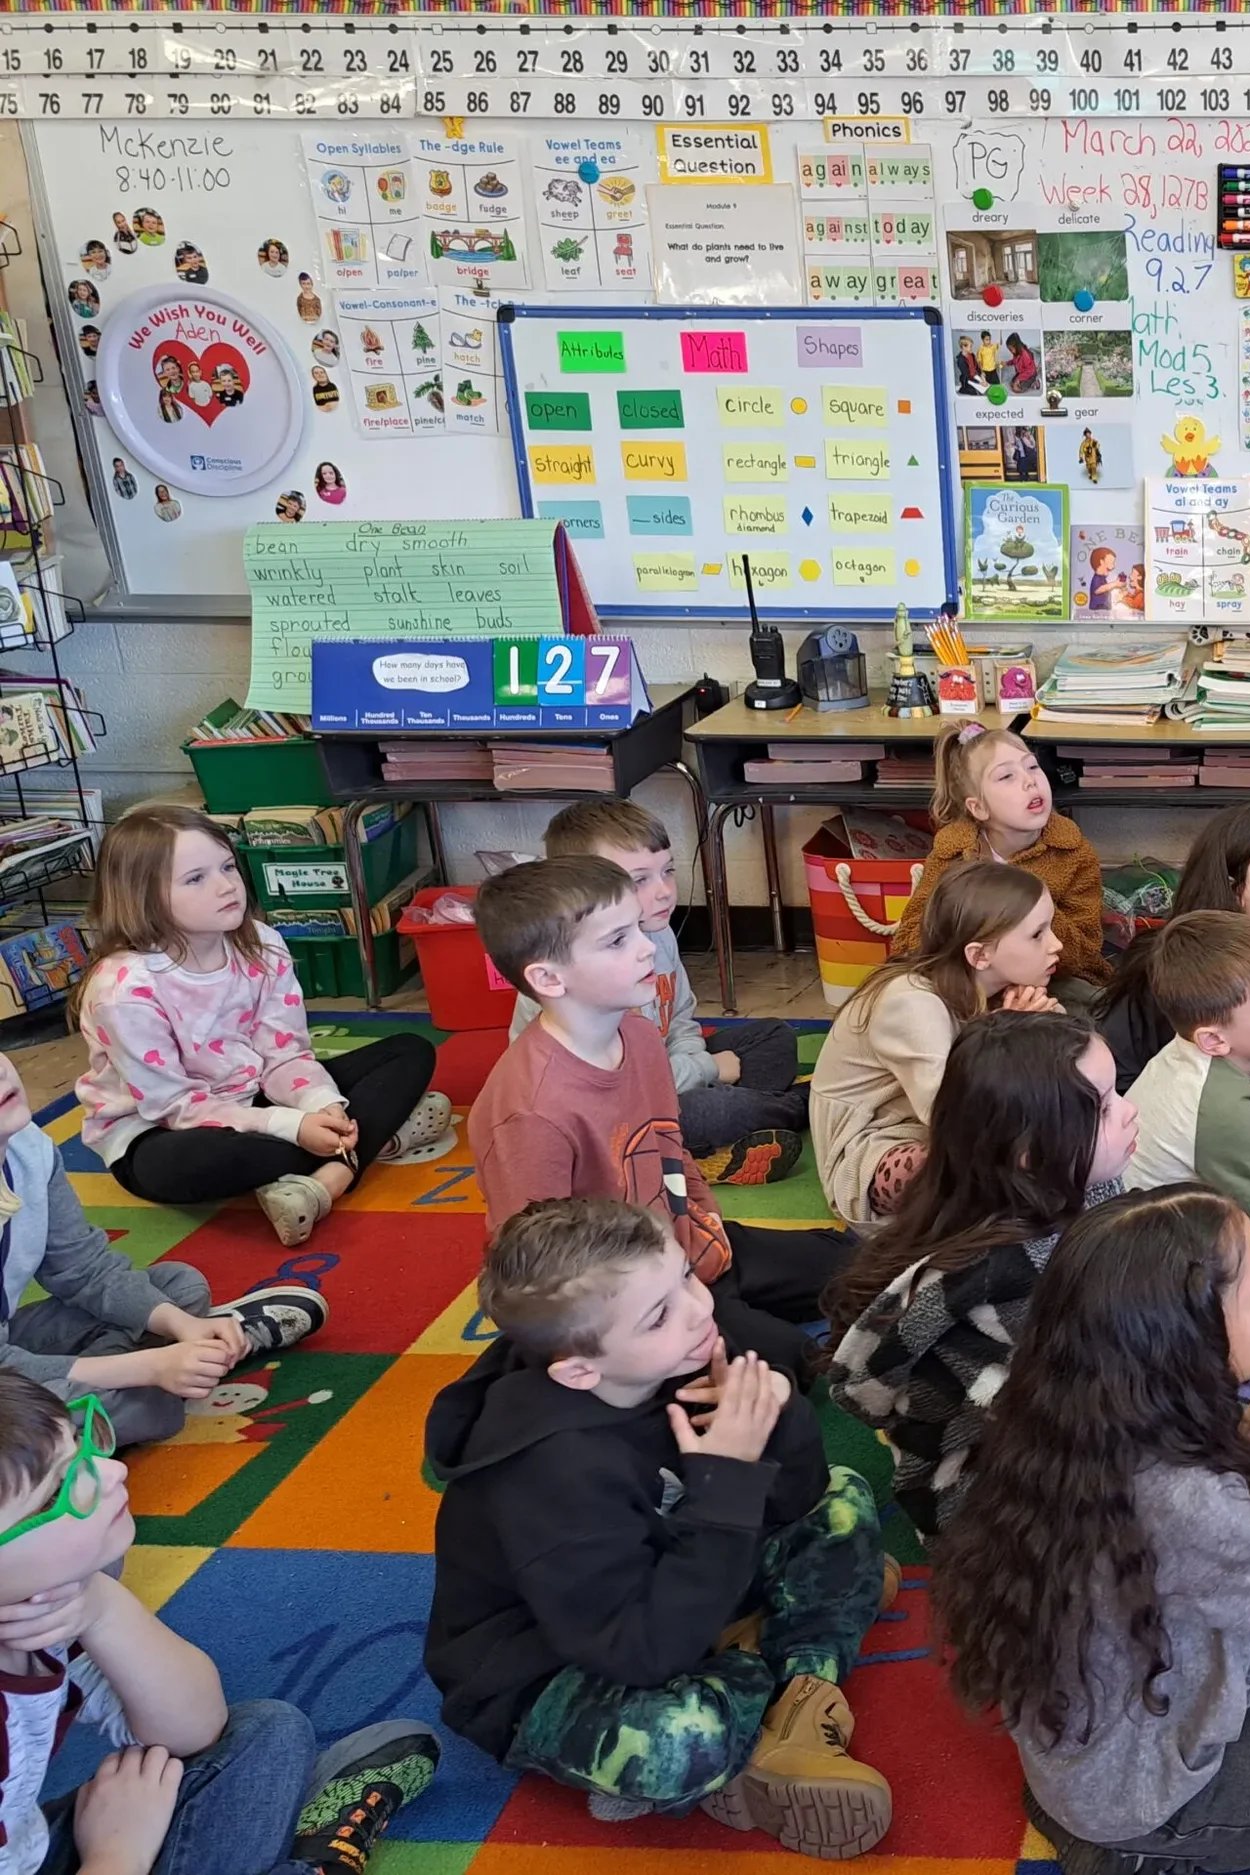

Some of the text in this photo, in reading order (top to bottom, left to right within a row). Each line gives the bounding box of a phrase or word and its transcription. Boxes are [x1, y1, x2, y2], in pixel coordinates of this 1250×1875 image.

[44, 48, 63, 70] 16
[128, 48, 147, 69] 18
[344, 49, 367, 72] 23
[517, 50, 539, 72] 27
[647, 50, 670, 73] 30
[819, 49, 842, 72] 34
[950, 49, 971, 71] 37
[1167, 48, 1189, 71] 42
[39, 93, 60, 114] 76
[467, 92, 488, 112] 86
[599, 94, 620, 115] 89
[728, 94, 751, 116] 92
[901, 91, 924, 114] 96
[1069, 89, 1098, 110] 100
[832, 123, 902, 138] Phonics
[1061, 119, 1155, 157] March
[99, 124, 233, 160] McKenzie
[316, 141, 402, 156] Open Syllables
[478, 142, 505, 154] Rule
[545, 139, 622, 152] Vowel Teams
[672, 133, 758, 150] Essential
[674, 158, 756, 175] Question
[1039, 172, 1112, 206] Week
[425, 202, 508, 215] badge fudge
[551, 210, 634, 221] sheep greet
[972, 212, 1102, 226] dreary delicate
[667, 243, 755, 252] What plants need
[705, 255, 722, 263] and
[456, 265, 490, 278] bridge
[561, 266, 637, 276] leaf seat
[967, 310, 1104, 325] discoveries corner
[128, 304, 267, 356] We Wish You Well
[175, 322, 222, 342] Aden
[688, 333, 744, 371] Math
[804, 335, 860, 359] Shapes
[454, 352, 481, 363] hatch
[456, 413, 485, 423] match
[531, 398, 885, 424] open closed circle square
[974, 407, 1099, 422] expected gear
[535, 455, 593, 481] straight
[727, 455, 788, 476] rectangle
[832, 449, 891, 476] triangle
[989, 500, 1040, 513] Curious
[729, 502, 889, 527] rhombus trapezoid
[997, 512, 1041, 525] Garden
[256, 531, 468, 557] bean dry smooth
[1166, 547, 1189, 556] train
[1216, 547, 1241, 556] chain
[254, 552, 530, 589] wrinkly plant skin soil
[835, 559, 887, 580] octagon
[267, 581, 502, 607] watered stalk leaves
[1169, 599, 1186, 611] hay
[1216, 600, 1242, 611] spray
[270, 606, 513, 639] sprouted sunshine buds
[380, 660, 465, 670] How many days have
[398, 675, 462, 684] been school?
[499, 714, 537, 722] Hundreds
[275, 868, 340, 878] Magic Tree
[292, 880, 327, 888] House
